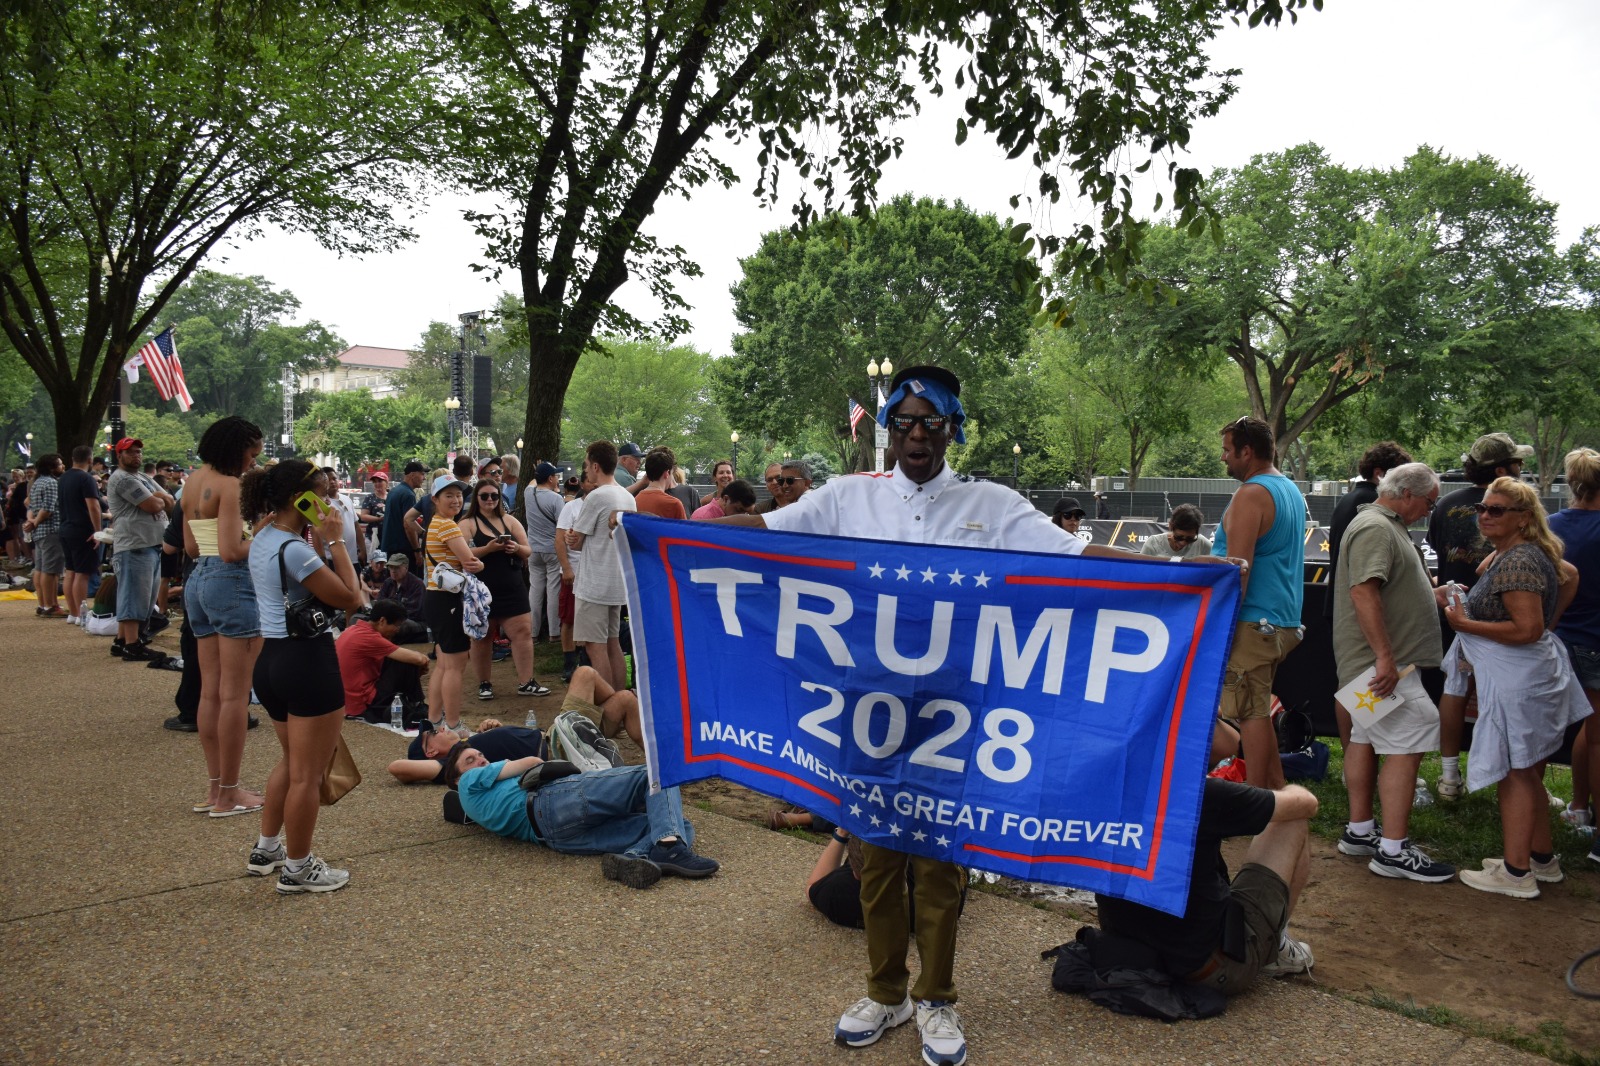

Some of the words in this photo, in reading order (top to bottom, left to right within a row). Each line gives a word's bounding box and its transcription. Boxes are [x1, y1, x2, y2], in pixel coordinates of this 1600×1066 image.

[689, 567, 1170, 704] TRUMP
[699, 720, 774, 756] MAKE
[779, 739, 887, 808] AMERICA
[893, 791, 995, 832] GREAT
[1001, 812, 1144, 850] FOREVER
[798, 680, 1036, 784] 2028
